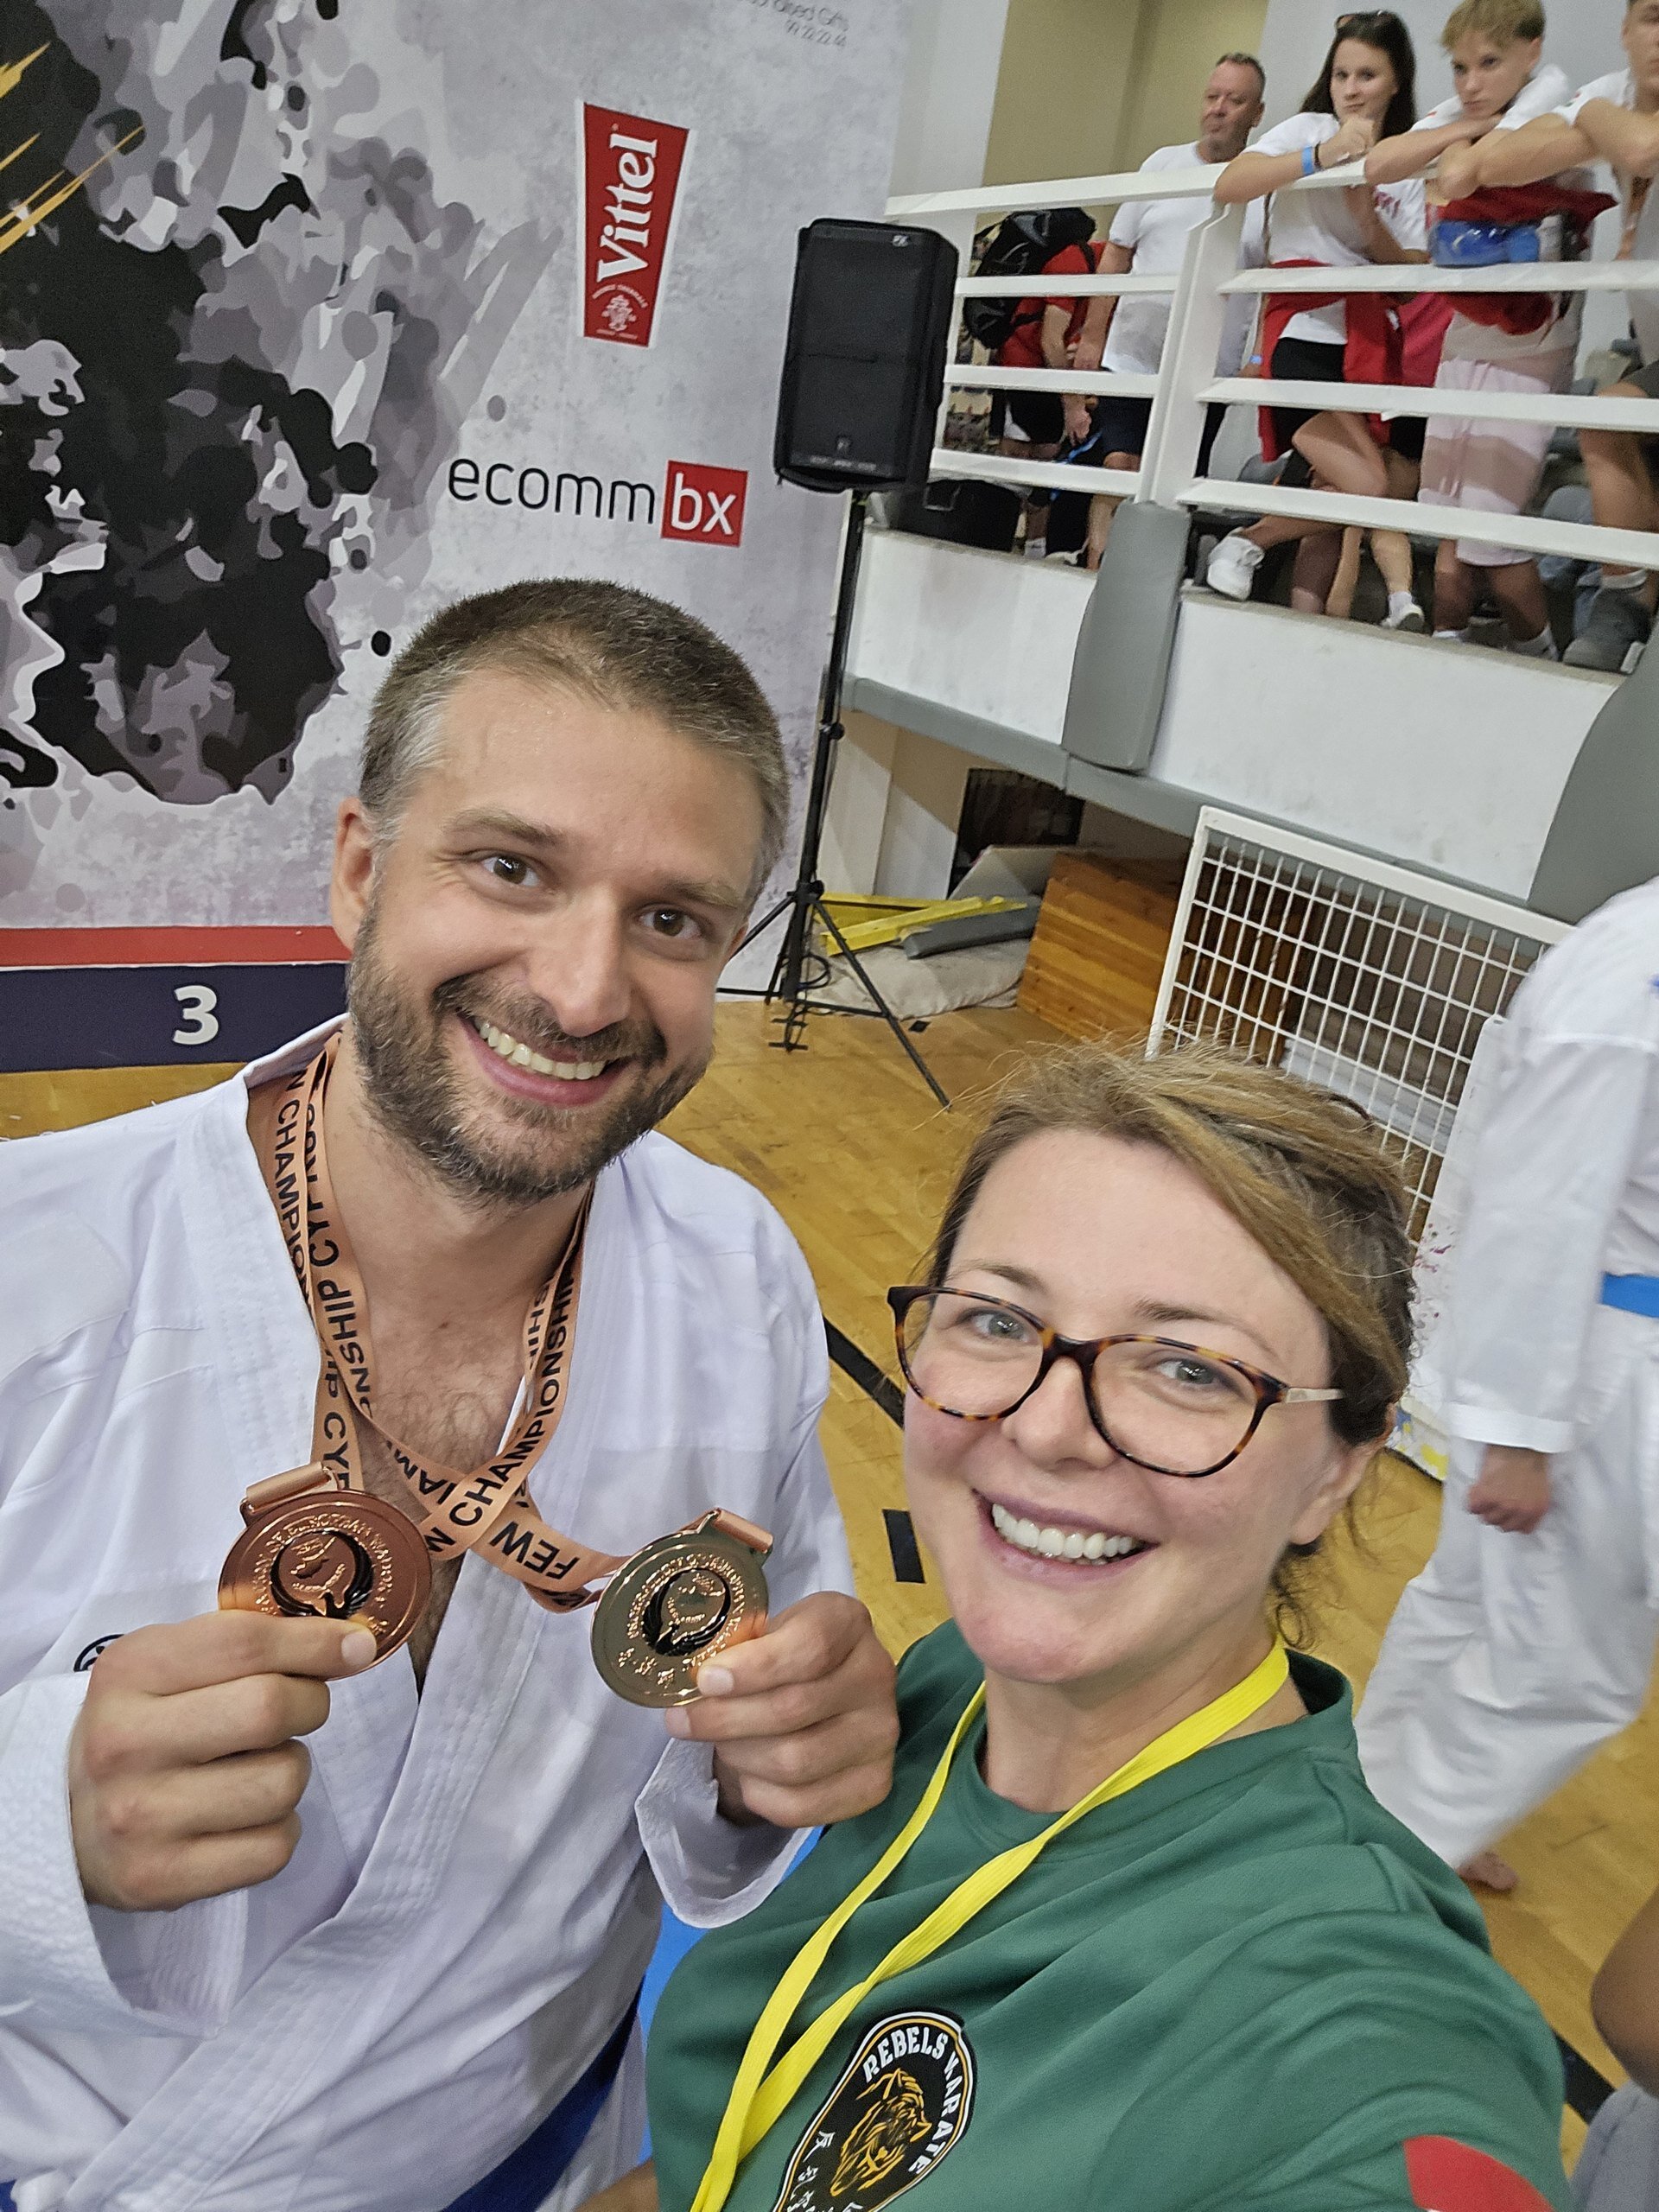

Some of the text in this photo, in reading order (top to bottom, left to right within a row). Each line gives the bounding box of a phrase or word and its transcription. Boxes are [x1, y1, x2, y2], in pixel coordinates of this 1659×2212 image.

[596, 132, 658, 283] Vittel
[173, 985, 219, 1045] 3
[488, 1521, 580, 1580] FEW
[862, 2026, 963, 2175] REBELS KARATE
